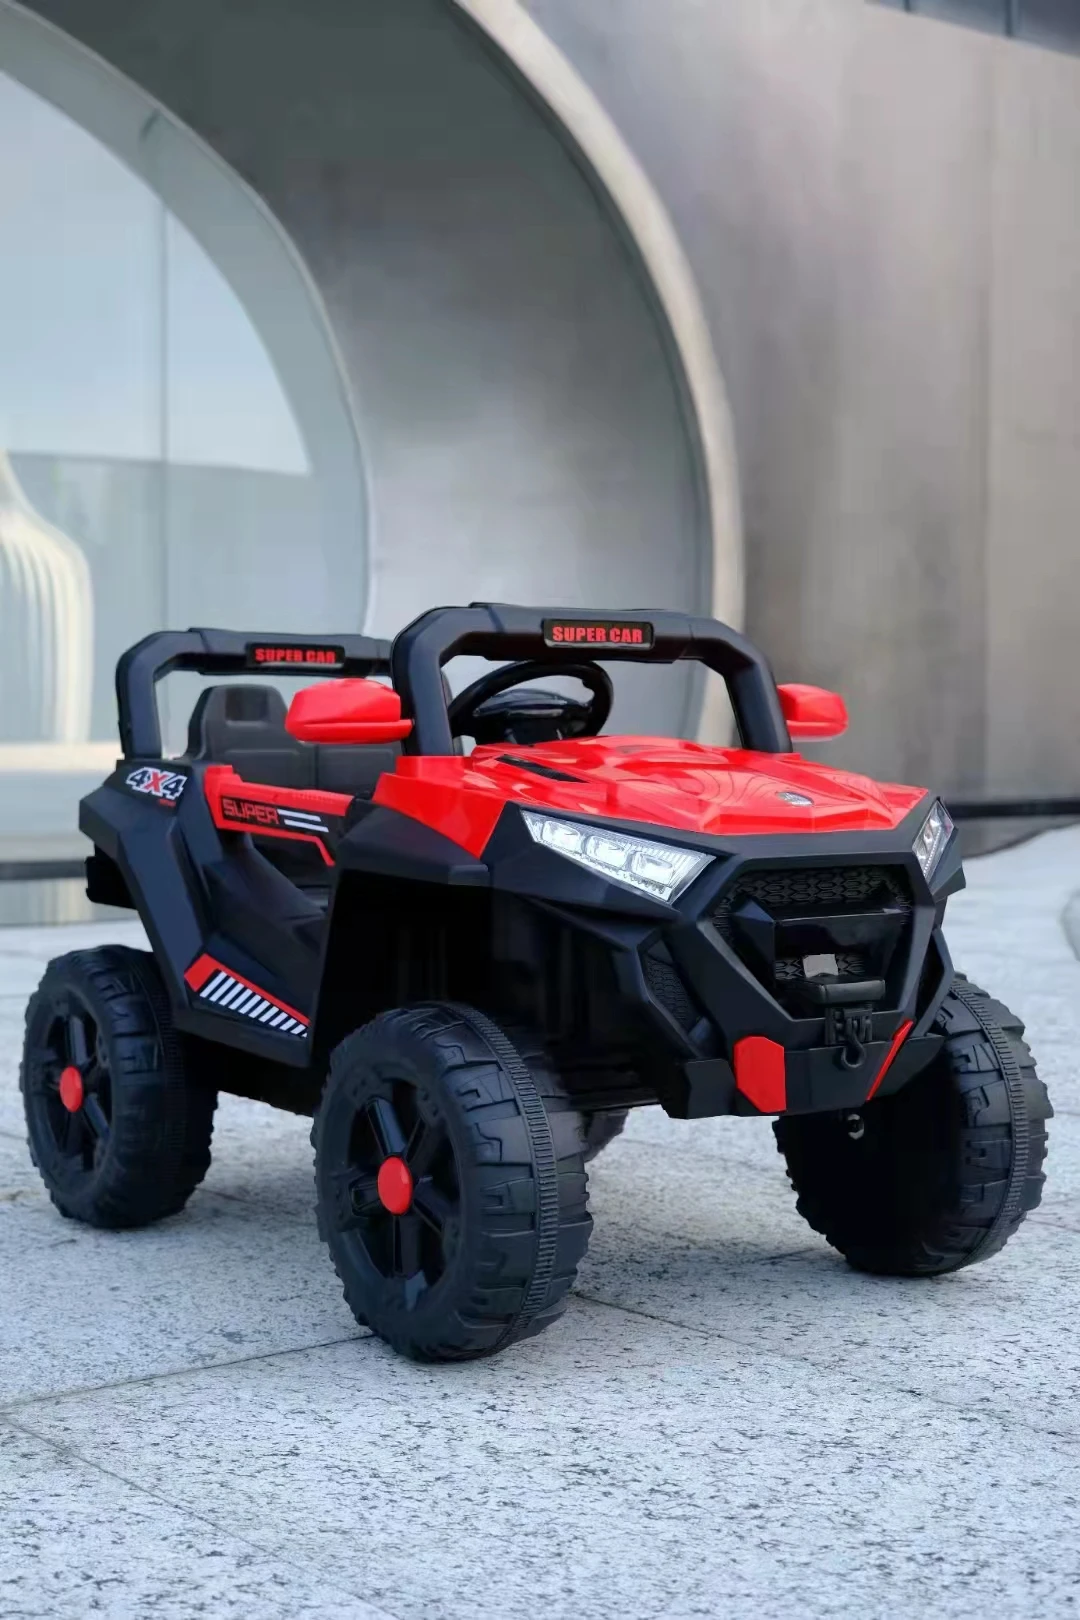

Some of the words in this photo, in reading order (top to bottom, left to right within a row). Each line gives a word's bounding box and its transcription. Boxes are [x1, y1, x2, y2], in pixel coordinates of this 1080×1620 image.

[552, 626, 606, 642] SUPER
[609, 628, 643, 643] CAR
[255, 648, 303, 662] SUPER
[305, 650, 336, 664] CAR
[126, 766, 187, 800] 4X4
[222, 799, 280, 825] SUPER
